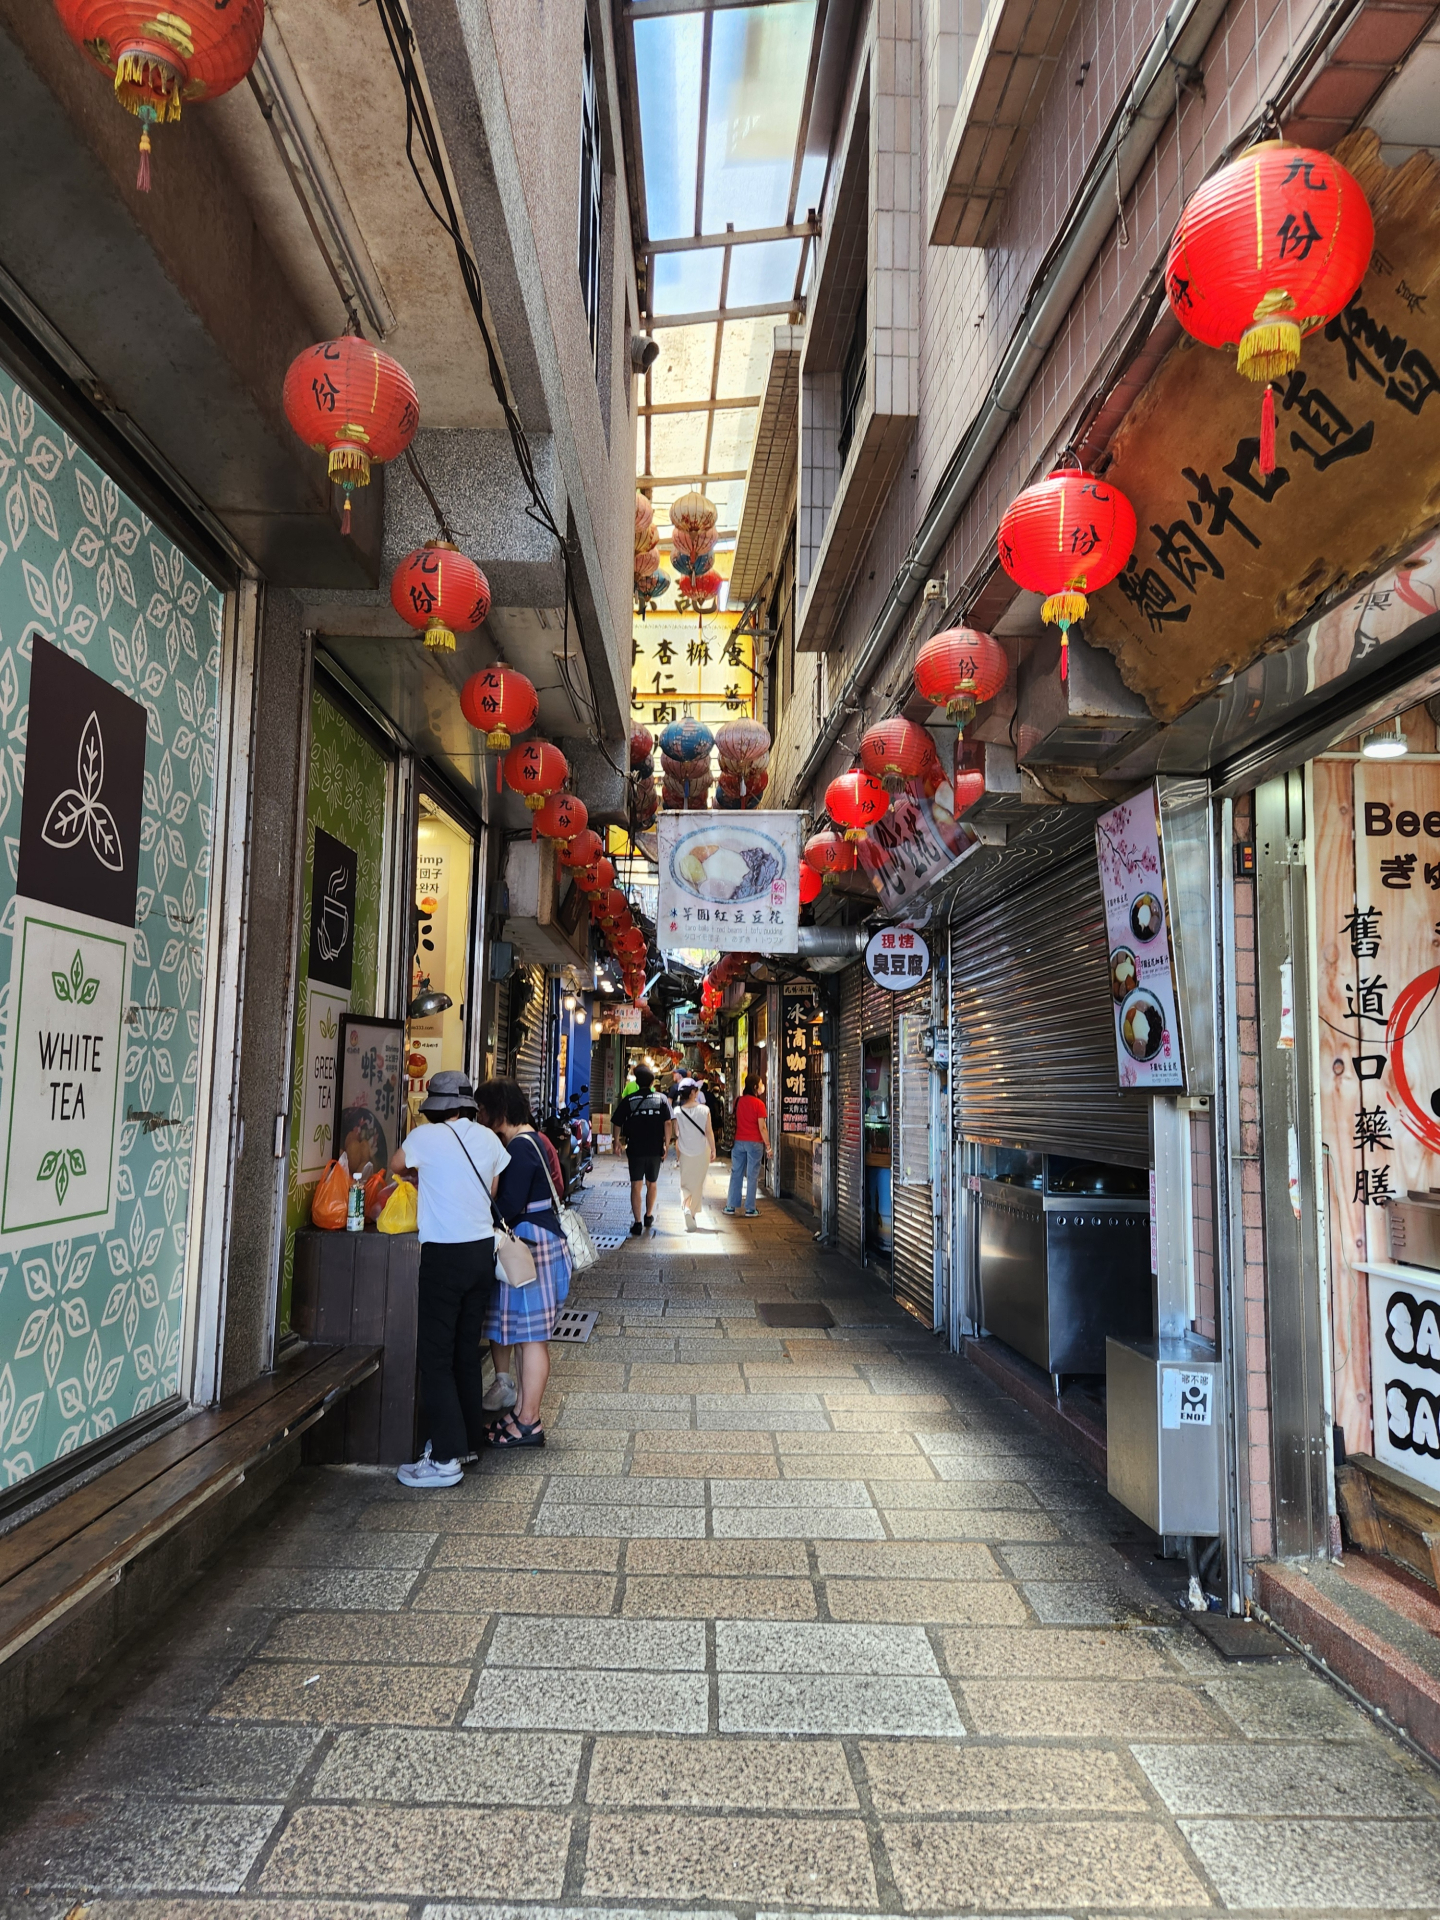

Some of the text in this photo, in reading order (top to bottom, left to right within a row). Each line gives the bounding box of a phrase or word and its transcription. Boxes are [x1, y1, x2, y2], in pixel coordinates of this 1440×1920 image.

[1276, 157, 1327, 261] 九份
[312, 341, 340, 412] 九份
[1071, 484, 1110, 556] 九份
[409, 551, 440, 614] 九份
[480, 673, 499, 713] 九份
[523, 747, 538, 780] 九份
[417, 883, 440, 894] 완자
[881, 934, 914, 948] 現烤
[873, 953, 923, 976] 臭豆腐
[39, 1031, 103, 1072] WHITE
[786, 1003, 808, 1096] 冰滴咖啡
[50, 1082, 85, 1121] TEA
[318, 1086, 331, 1109] TEA
